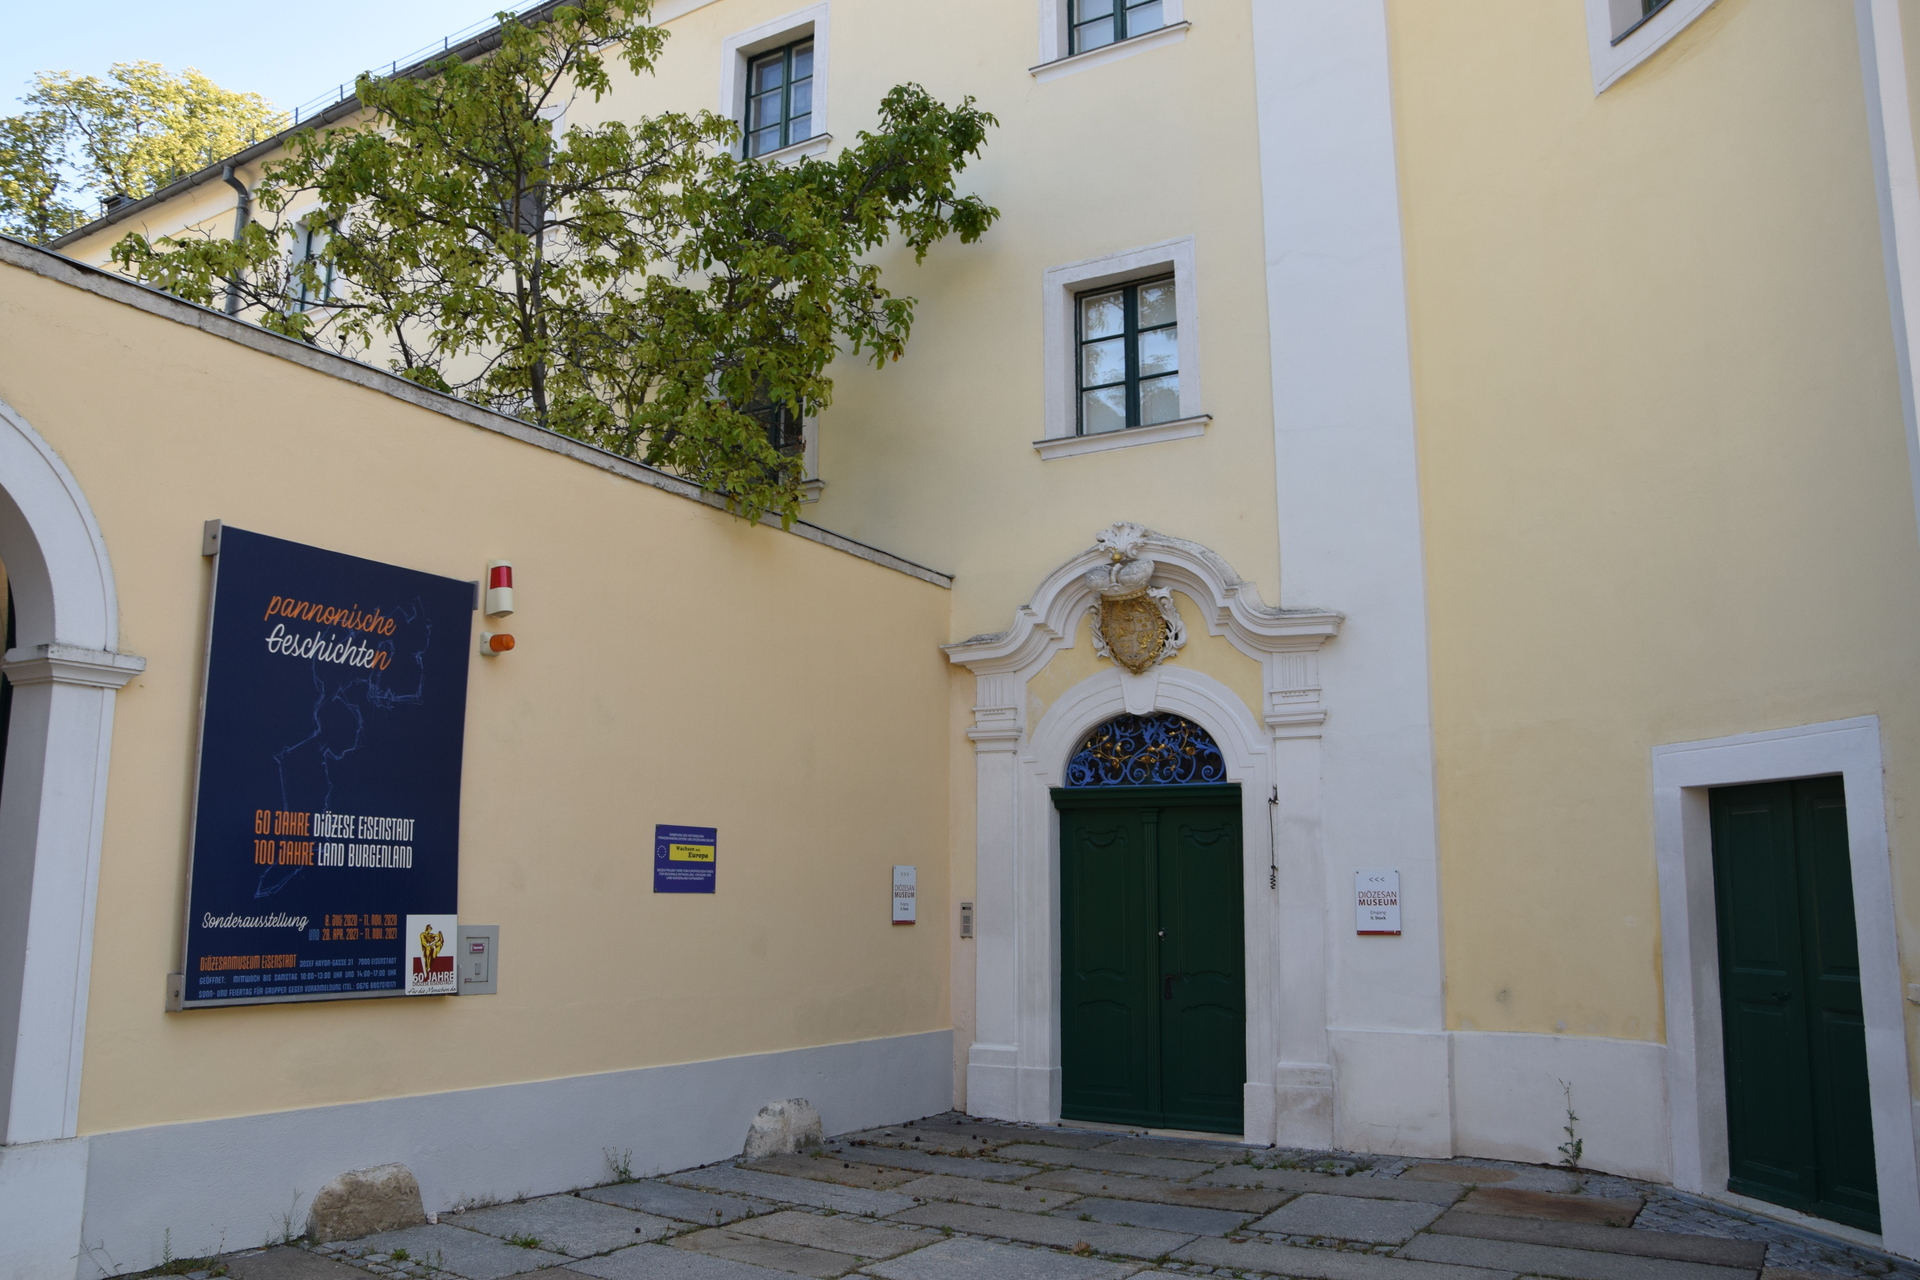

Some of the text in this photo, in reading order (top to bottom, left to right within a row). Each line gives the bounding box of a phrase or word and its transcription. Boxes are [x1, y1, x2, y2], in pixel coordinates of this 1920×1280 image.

[264, 596, 396, 636] pannonische
[265, 623, 392, 671] Geschichten
[255, 809, 271, 835] 60
[274, 811, 310, 836] JAHRE
[254, 839, 413, 869] 100 JAHRE LAND BURGENLAND
[688, 852, 709, 860] Europa
[1358, 890, 1396, 898] DIÖZESAN
[202, 912, 309, 932] Sonderausstellung
[343, 914, 358, 927] 2020
[371, 914, 383, 926] NOV.
[384, 914, 398, 926] 2020
[308, 928, 320, 941] UND
[332, 928, 345, 941] APR.
[345, 928, 359, 940] 2021
[372, 928, 384, 940] NOV.
[385, 928, 398, 940] 2021
[299, 960, 314, 968] JOSEF
[358, 957, 370, 966] 7000
[371, 957, 397, 965] EISENSTADT
[233, 975, 260, 983] MITTWOCH
[263, 974, 271, 982] BIS
[274, 973, 298, 982] SAMSTAG
[333, 971, 343, 979] UHR
[344, 970, 354, 978] UND
[413, 971, 454, 983] 60 JAHRE
[216, 989, 228, 997] UND
[229, 987, 253, 997] FEIERTAG
[253, 986, 264, 995] FÜR
[264, 986, 287, 995] GRUPPEN
[288, 985, 304, 994] GEGEN
